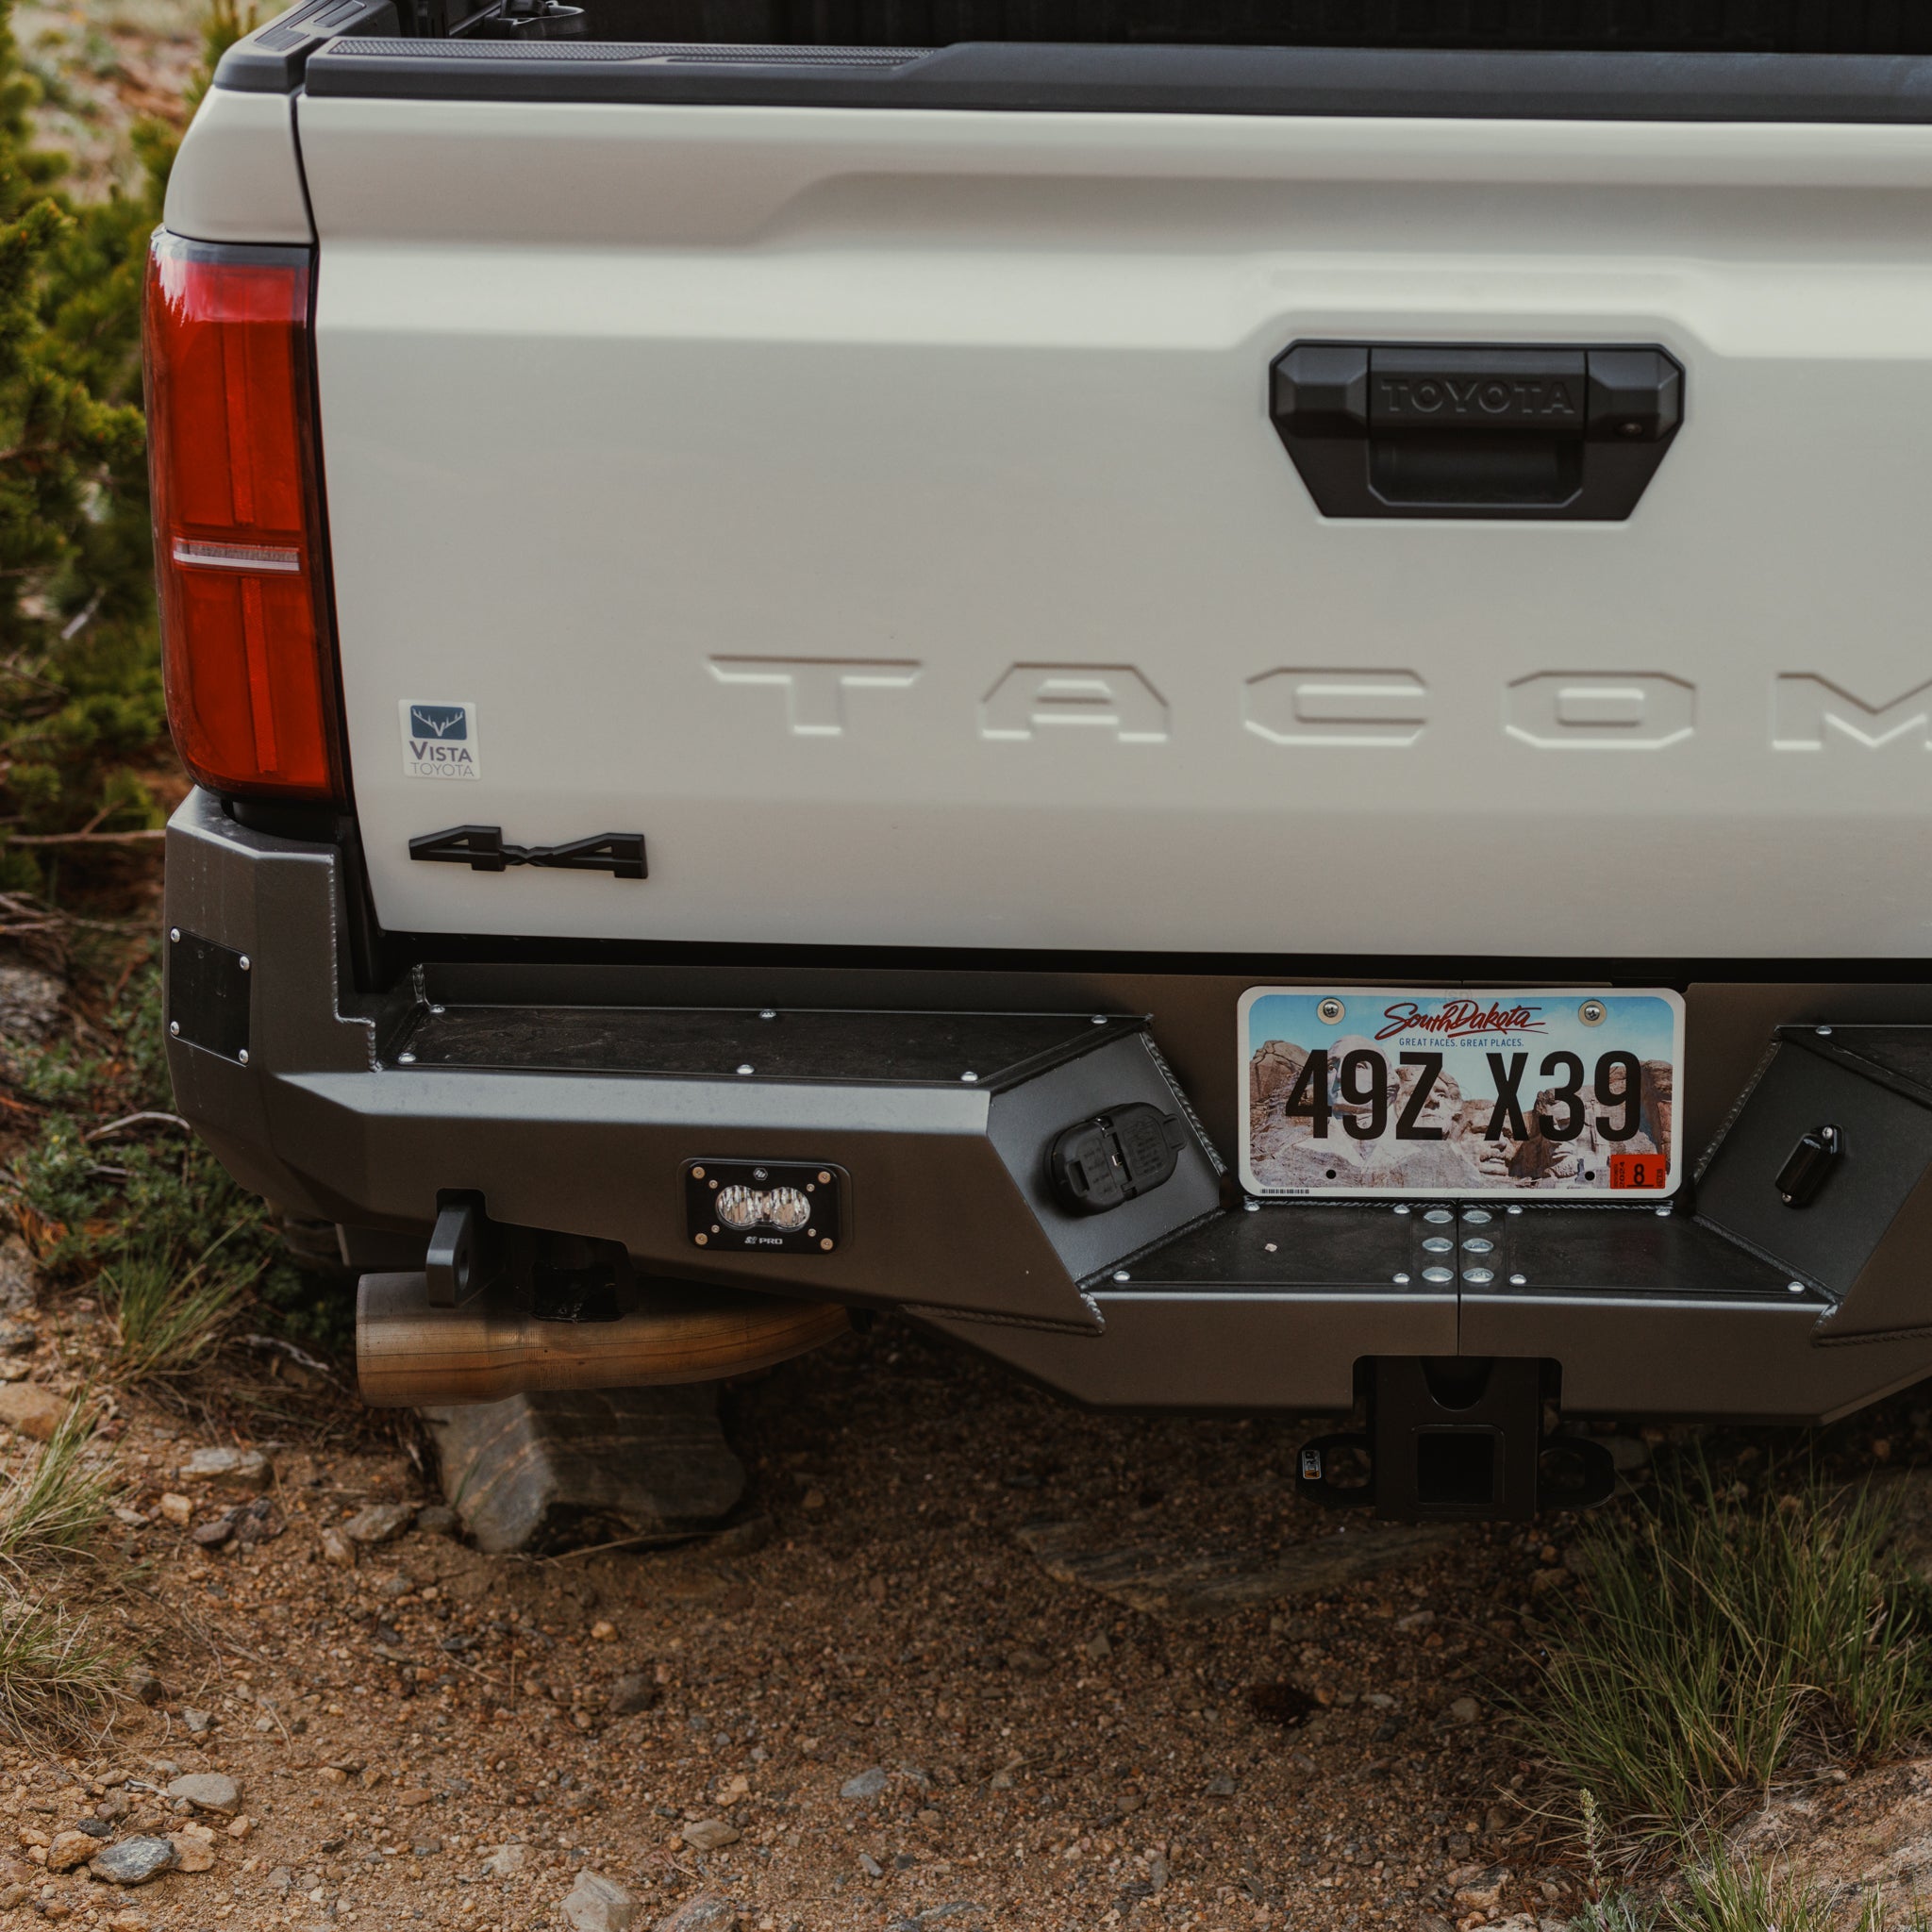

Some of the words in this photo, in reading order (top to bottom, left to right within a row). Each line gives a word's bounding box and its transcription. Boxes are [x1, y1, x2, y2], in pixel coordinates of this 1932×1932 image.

[1380, 379, 1575, 414] TOYOTA
[409, 761, 475, 777] TOYOTA
[1374, 1002, 1457, 1040] South
[1443, 1000, 1547, 1037] Dakota
[1399, 1038, 1426, 1046] GREAT
[1429, 1038, 1457, 1047] FACES.
[1460, 1039, 1488, 1047] GREAT
[1491, 1039, 1524, 1047] PLACES.
[1285, 1049, 1443, 1141] 49Z
[1484, 1050, 1641, 1141] X39
[1633, 1163, 1645, 1186] 8
[758, 1237, 783, 1245] PRO
